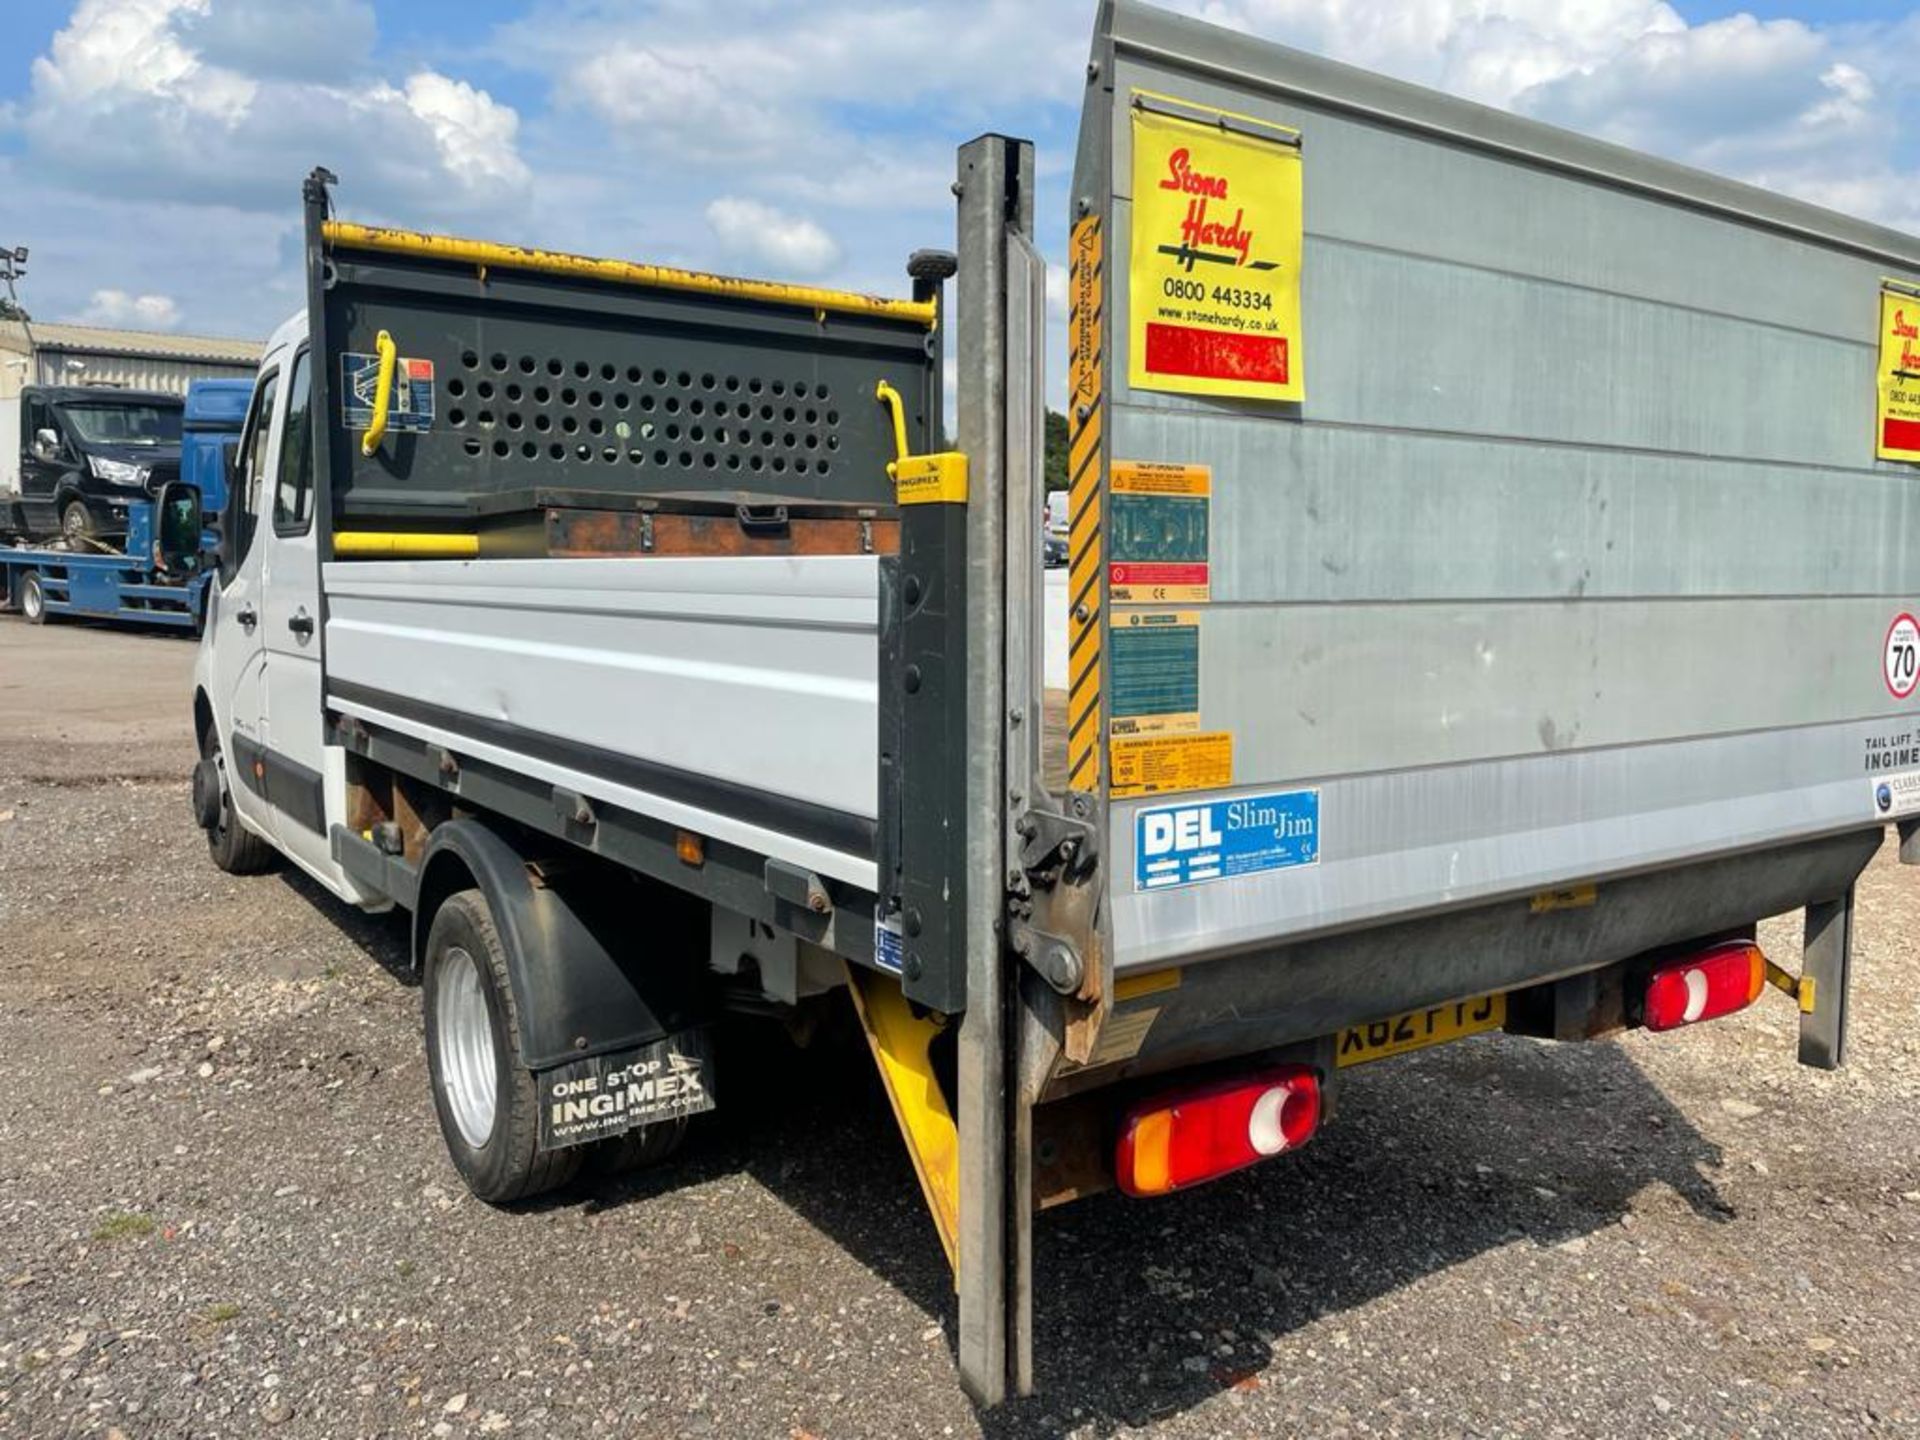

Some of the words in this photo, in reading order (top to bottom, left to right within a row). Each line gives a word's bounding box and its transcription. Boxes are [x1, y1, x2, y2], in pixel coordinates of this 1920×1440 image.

[1160, 148, 1227, 199] Stone
[1181, 199, 1253, 266] Hardy
[1164, 278, 1205, 302] 0800
[1212, 286, 1272, 311] 443334
[1158, 307, 1279, 332] www.stonehardy.co.uk
[1892, 645, 1915, 678] 70
[1865, 737, 1887, 750] TAIL
[1891, 734, 1911, 747] LIFT
[1145, 808, 1222, 856] DEL
[1227, 801, 1277, 830] Slim
[1274, 812, 1313, 839] Jim
[552, 1077, 597, 1097] ONE
[607, 1060, 661, 1087] STOP
[552, 1073, 702, 1124] INGIMEX
